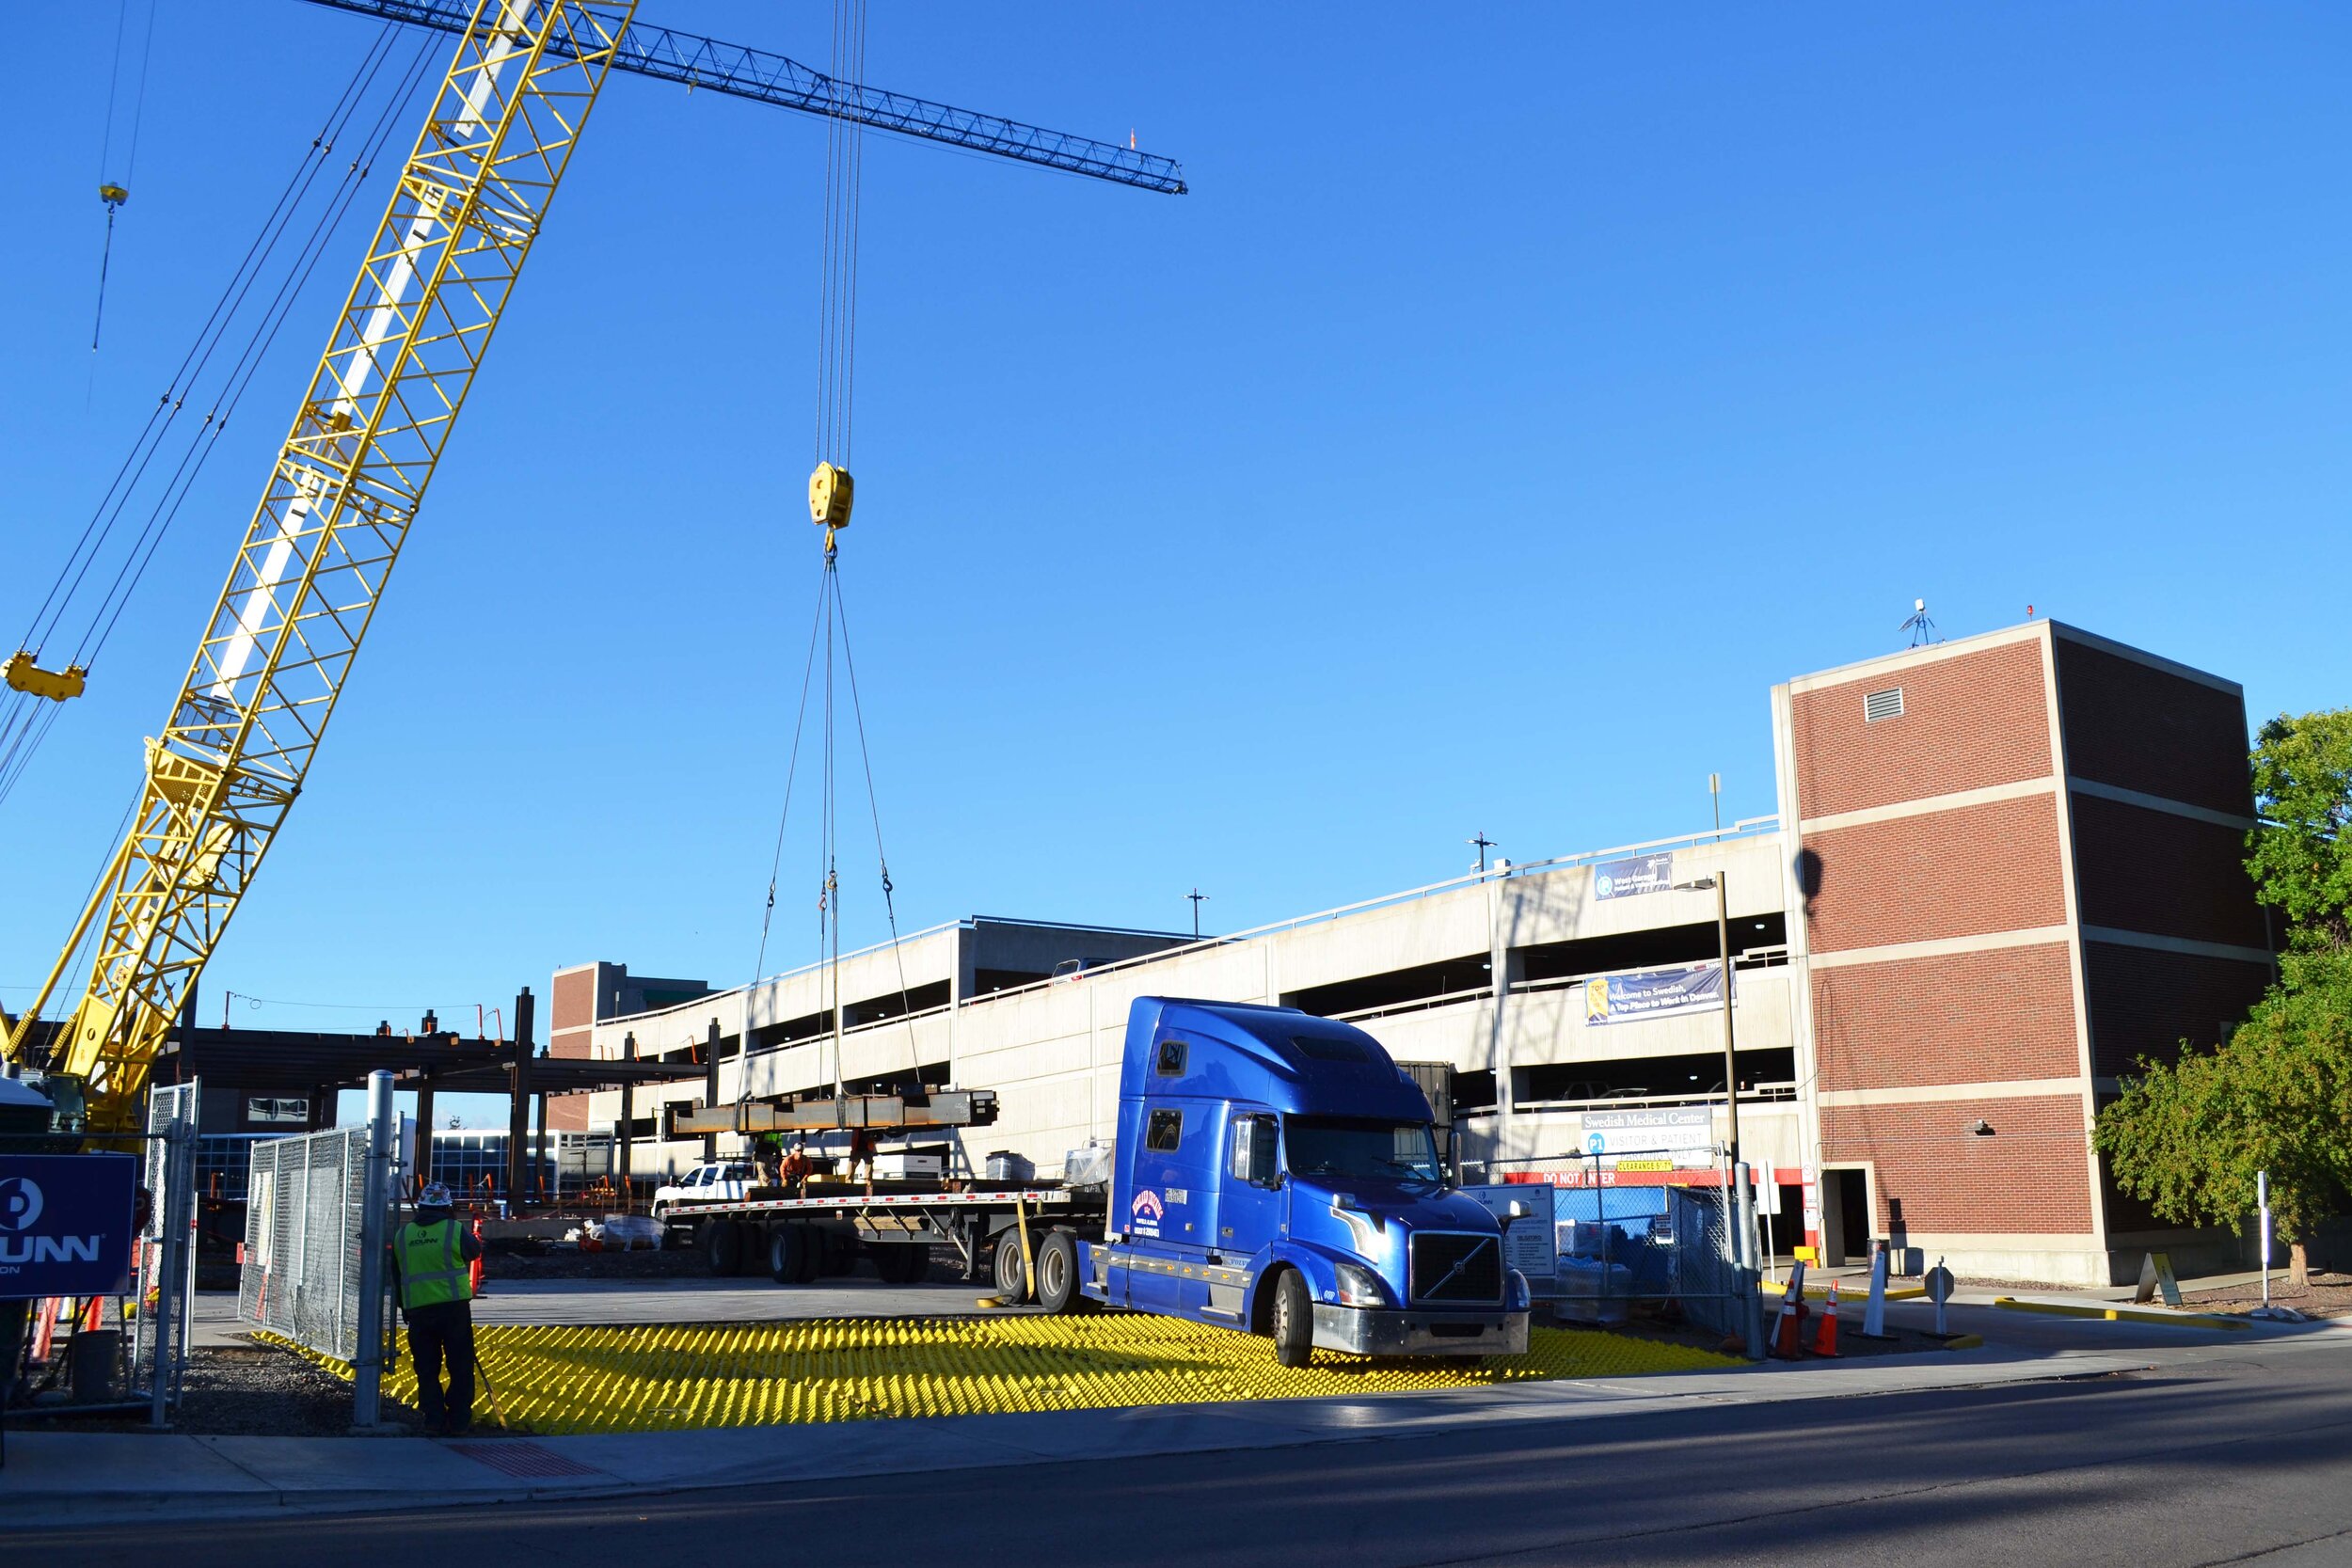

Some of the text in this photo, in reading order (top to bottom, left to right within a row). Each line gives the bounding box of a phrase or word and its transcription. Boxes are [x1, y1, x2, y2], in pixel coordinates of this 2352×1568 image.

[1613, 877, 1631, 885] West
[1610, 991, 1642, 1002] Welcome
[1652, 984, 1687, 996] Swedish,
[1610, 1004, 1616, 1012] A
[1616, 1003, 1629, 1013] Top
[1629, 1001, 1650, 1010] Place
[1661, 997, 1680, 1006] Work
[1680, 994, 1689, 1003] in
[1689, 991, 1719, 1002] Denver.
[1584, 1112, 1706, 1129] Swedish Medical Center
[1589, 1138, 1603, 1150] P1
[1610, 1132, 1702, 1147] VISITOR & PATIENT
[1666, 1149, 1692, 1160] ONLY
[1618, 1162, 1655, 1171] CLEARANCE
[1543, 1173, 1557, 1184] DO
[1559, 1173, 1580, 1184] NOT
